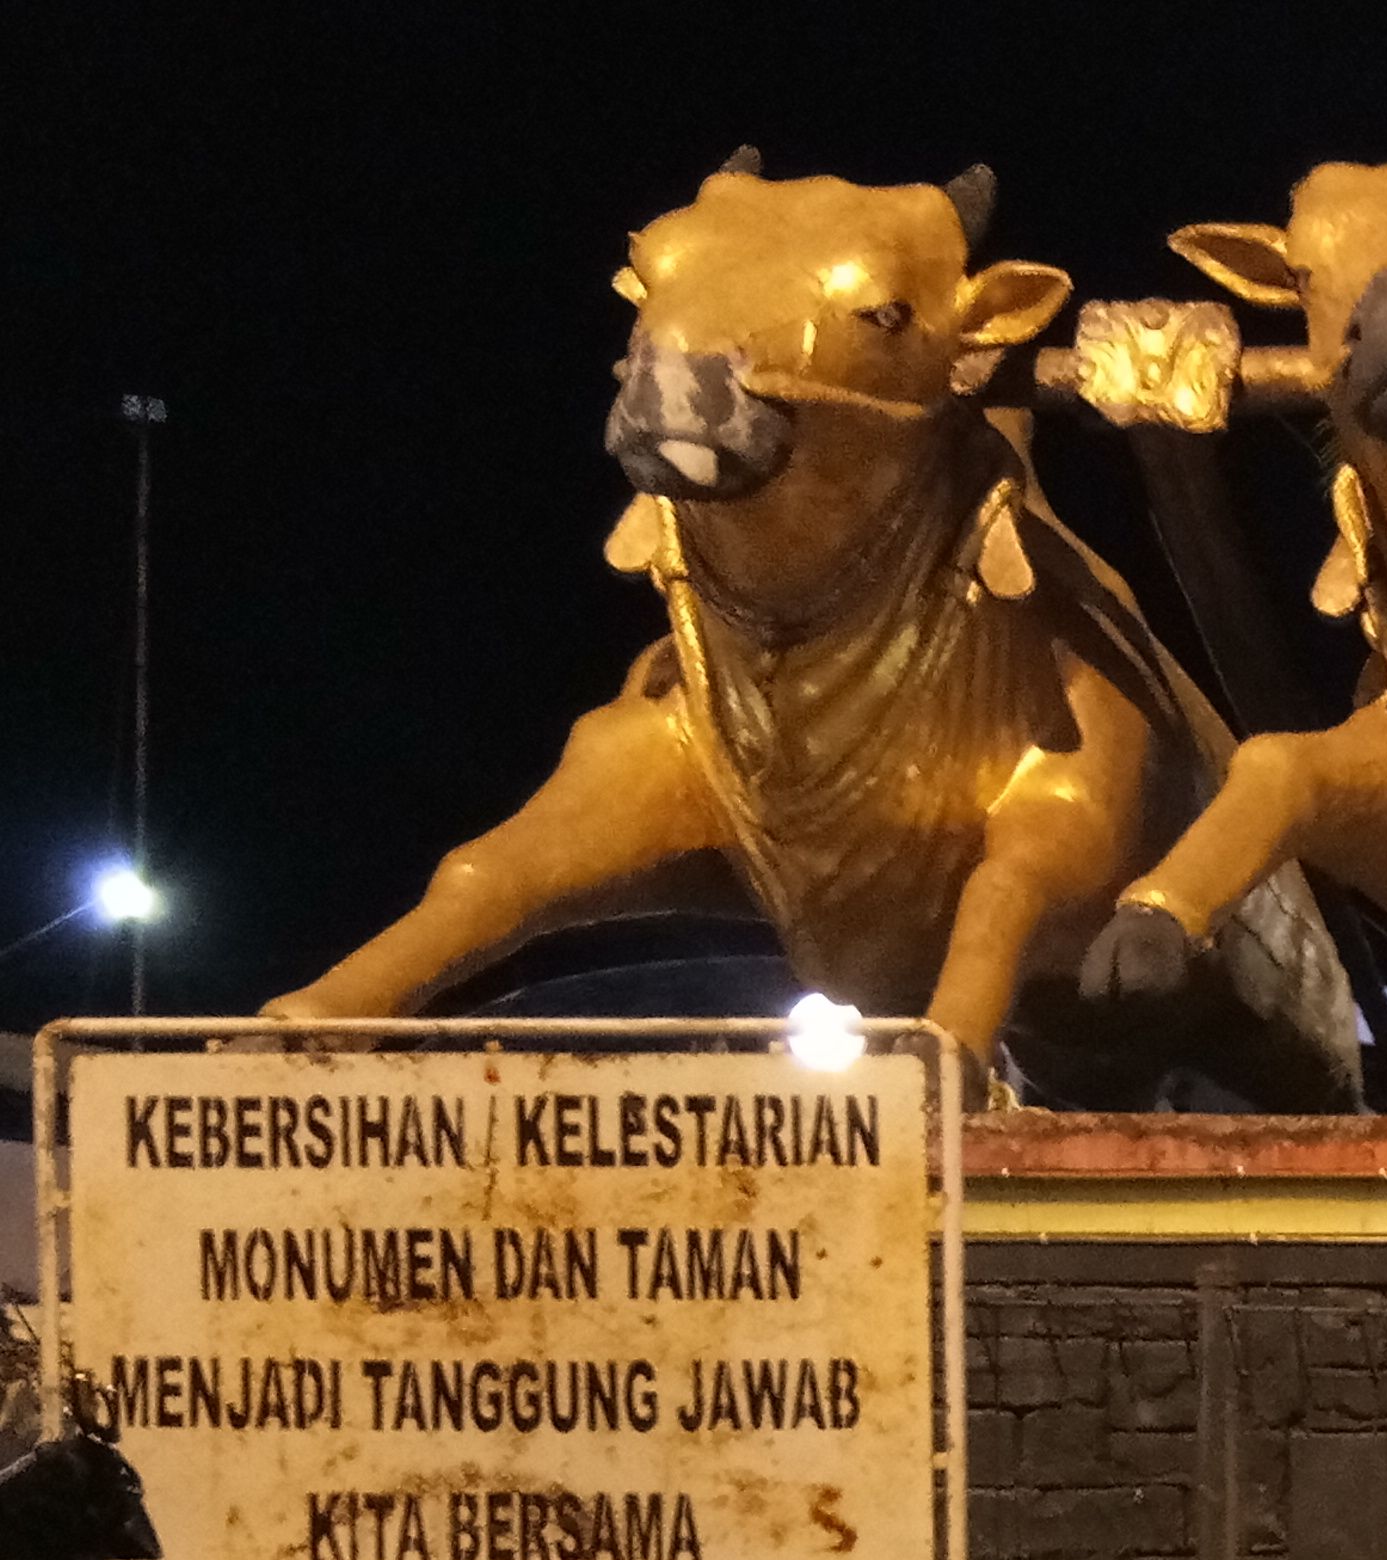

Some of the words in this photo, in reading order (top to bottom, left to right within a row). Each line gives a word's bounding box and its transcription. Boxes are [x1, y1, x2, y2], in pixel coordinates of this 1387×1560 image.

[126, 1094, 467, 1168] KEBERSIHAN
[514, 1092, 881, 1168] KELESTARIAN
[201, 1226, 475, 1302] MONUMEN
[494, 1227, 599, 1301] DAN
[616, 1226, 801, 1301] TAMAN
[112, 1354, 343, 1430] MENJADI
[361, 1359, 660, 1433] TANGGUNG
[677, 1357, 861, 1432] JAWAB
